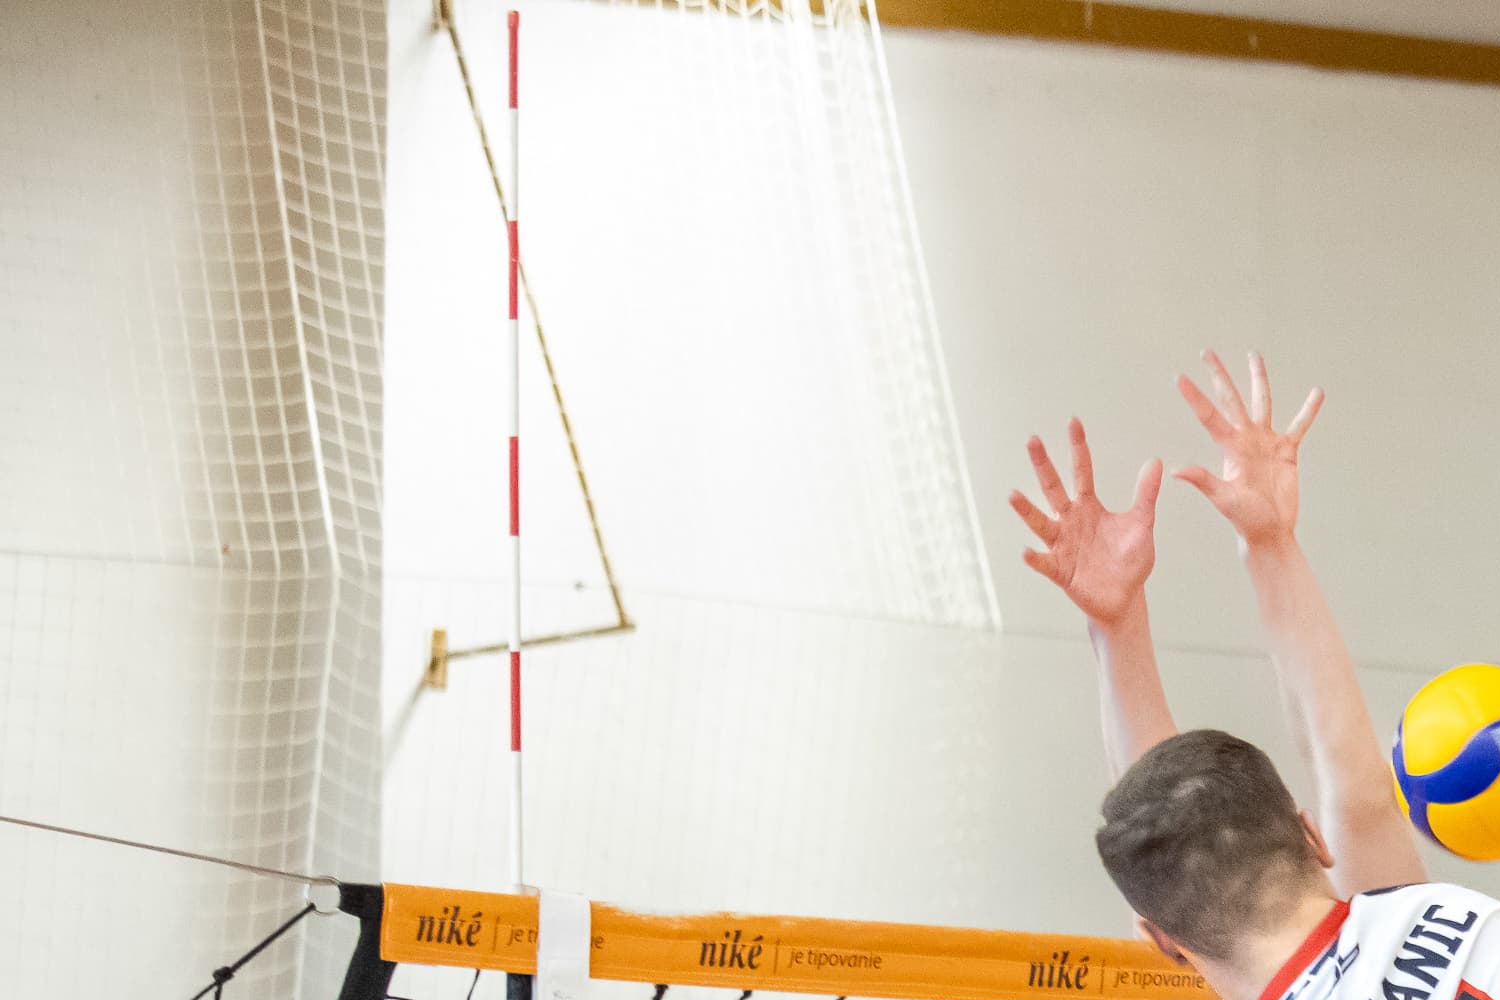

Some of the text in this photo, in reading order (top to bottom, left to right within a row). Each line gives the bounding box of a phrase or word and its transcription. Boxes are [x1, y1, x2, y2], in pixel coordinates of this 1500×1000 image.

[416, 906, 483, 947] niké
[506, 923, 523, 946] je
[699, 930, 886, 970] niké je tipovanie
[1028, 951, 1205, 990] niké je tipovanie
